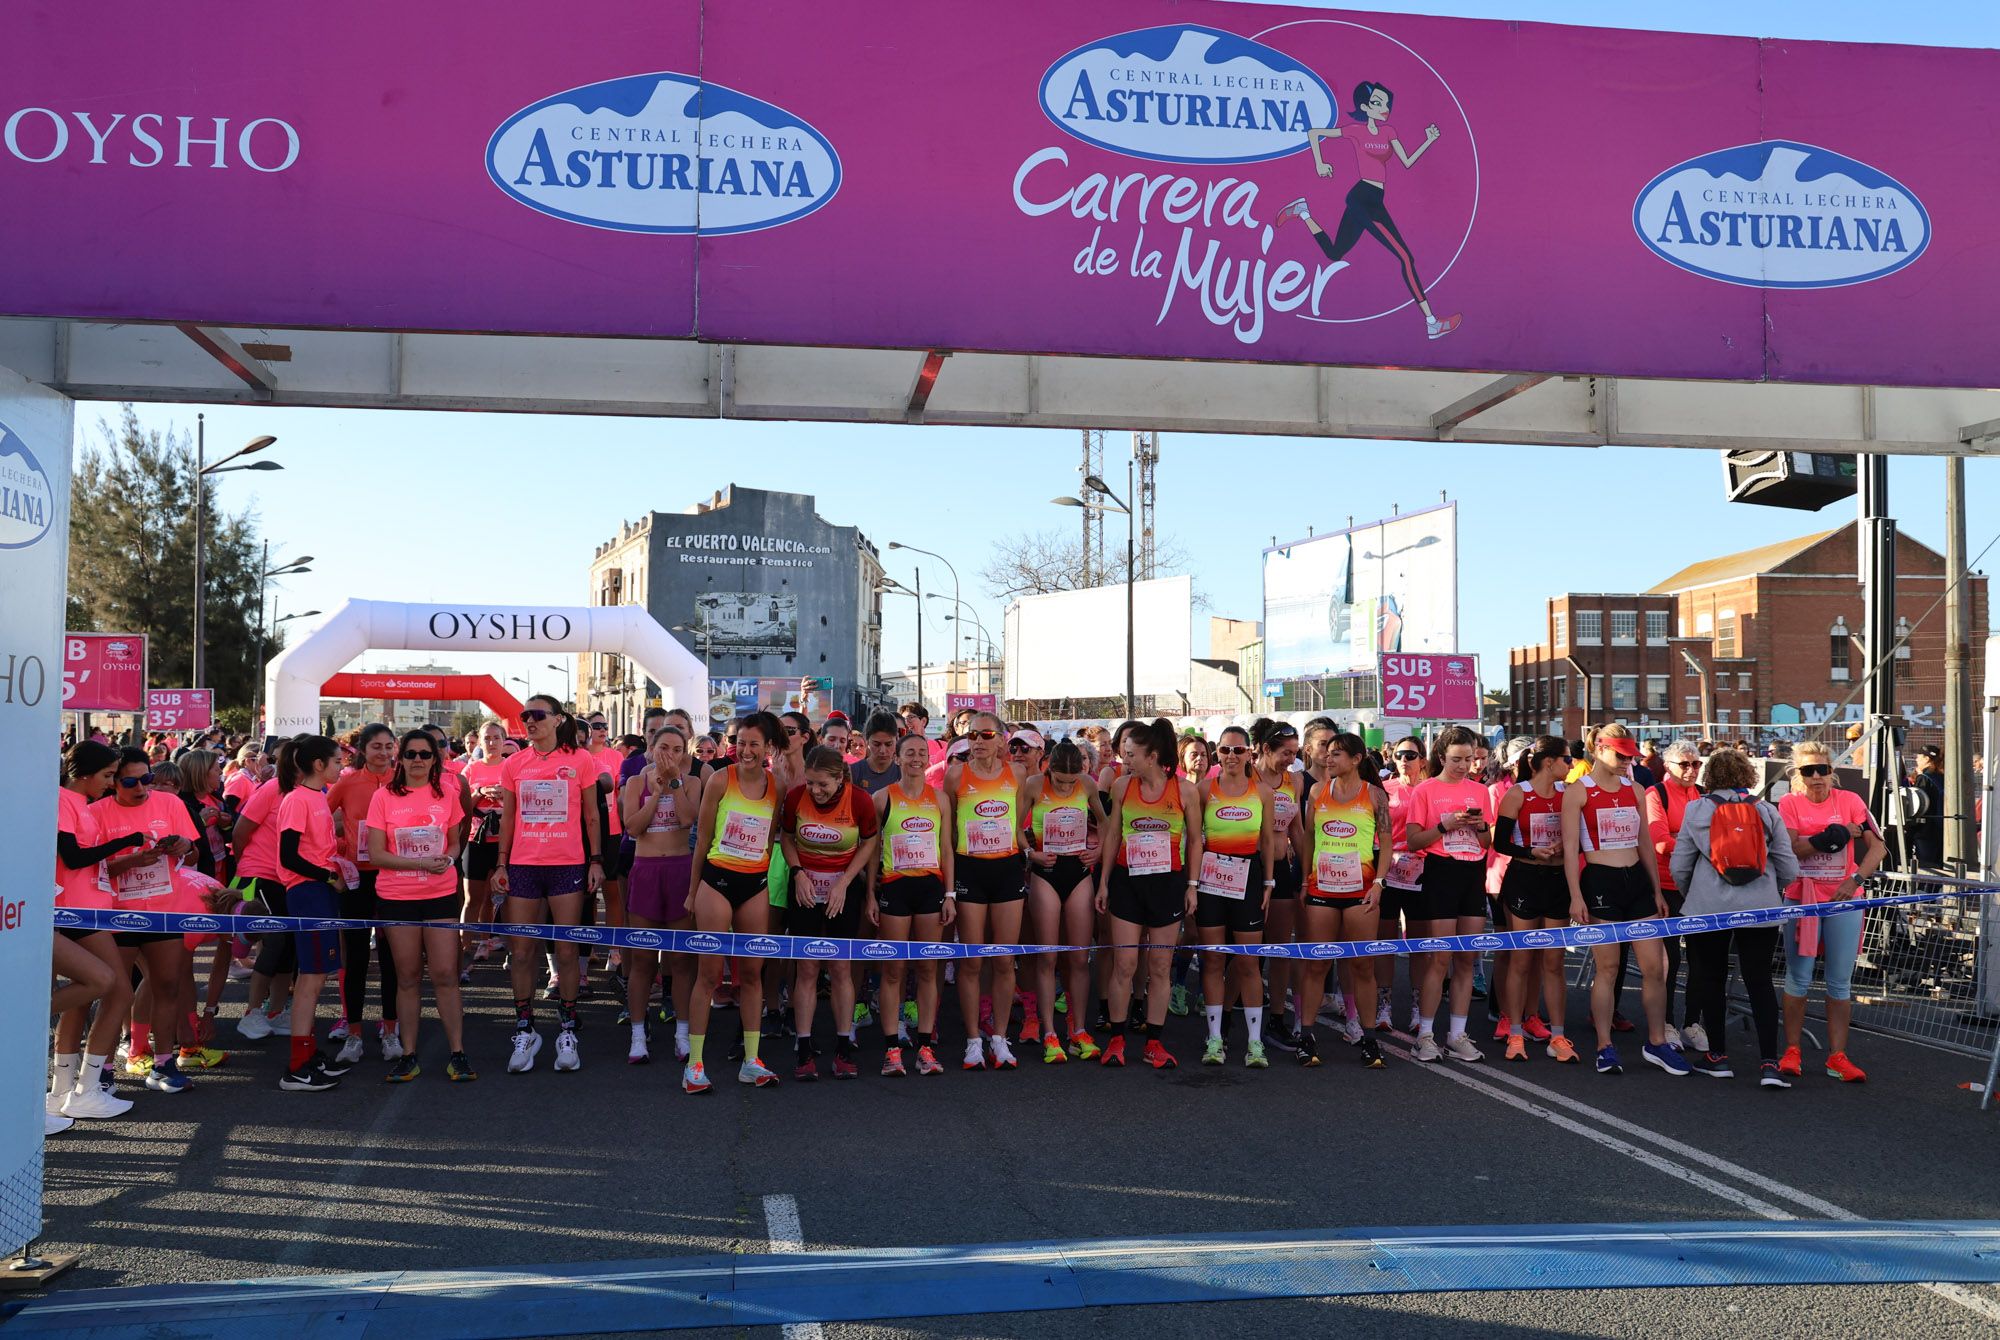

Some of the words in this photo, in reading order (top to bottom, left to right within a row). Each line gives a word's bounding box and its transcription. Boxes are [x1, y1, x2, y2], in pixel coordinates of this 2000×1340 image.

[1109, 68, 1203, 86] CENTRAL
[1212, 74, 1306, 92] LECHERA
[1062, 68, 1313, 133] ASTURIANA
[4, 107, 300, 173] OYSHO
[571, 126, 681, 144] CENTRAL
[693, 130, 803, 151] LECHERA
[513, 127, 814, 198] ASTURIANA
[1012, 146, 1260, 229] Carrera
[1702, 189, 1794, 206] CENTRAL
[1804, 194, 1898, 209] LECHERA
[1656, 190, 1908, 253] ASTURIANA
[1073, 224, 1119, 275] de
[1130, 226, 1162, 280] la
[1155, 223, 1350, 344] Mujer
[2, 466, 42, 491] LECHERA
[666, 536, 682, 548] EL
[685, 534, 737, 550] PUERTO
[742, 535, 831, 554] VALENCIA.com
[680, 554, 757, 566] Restaurante
[429, 611, 571, 641] OYSHO
[103, 662, 141, 671] OYSHO
[1386, 657, 1432, 677] SUB
[360, 679, 385, 688] Sports
[397, 680, 437, 689] Santander
[1444, 678, 1475, 687] OYSHO
[721, 680, 758, 696] Mar
[150, 693, 182, 706] SUB
[953, 697, 975, 707] SUB
[1386, 684, 1437, 711] 25'
[149, 709, 184, 727] 35'
[274, 716, 314, 726] OYSHO
[535, 798, 554, 806] 016
[657, 810, 675, 819] 016
[979, 805, 1008, 814] Serrano
[1218, 809, 1251, 818] Serrano
[904, 821, 932, 829] Serrano
[1134, 821, 1168, 830] Serrano
[1325, 823, 1355, 834] Serrano
[1615, 824, 1631, 833] 016
[740, 833, 757, 843] 016
[802, 827, 839, 841] Serrano
[1059, 829, 1075, 838] 016
[982, 837, 1000, 846] 016
[412, 844, 430, 853] 016
[907, 851, 925, 859] 016
[1140, 850, 1158, 858] 016
[136, 871, 155, 881] 016
[1216, 872, 1234, 882] 016
[1330, 870, 1348, 878] 016
[812, 878, 830, 887] 016
